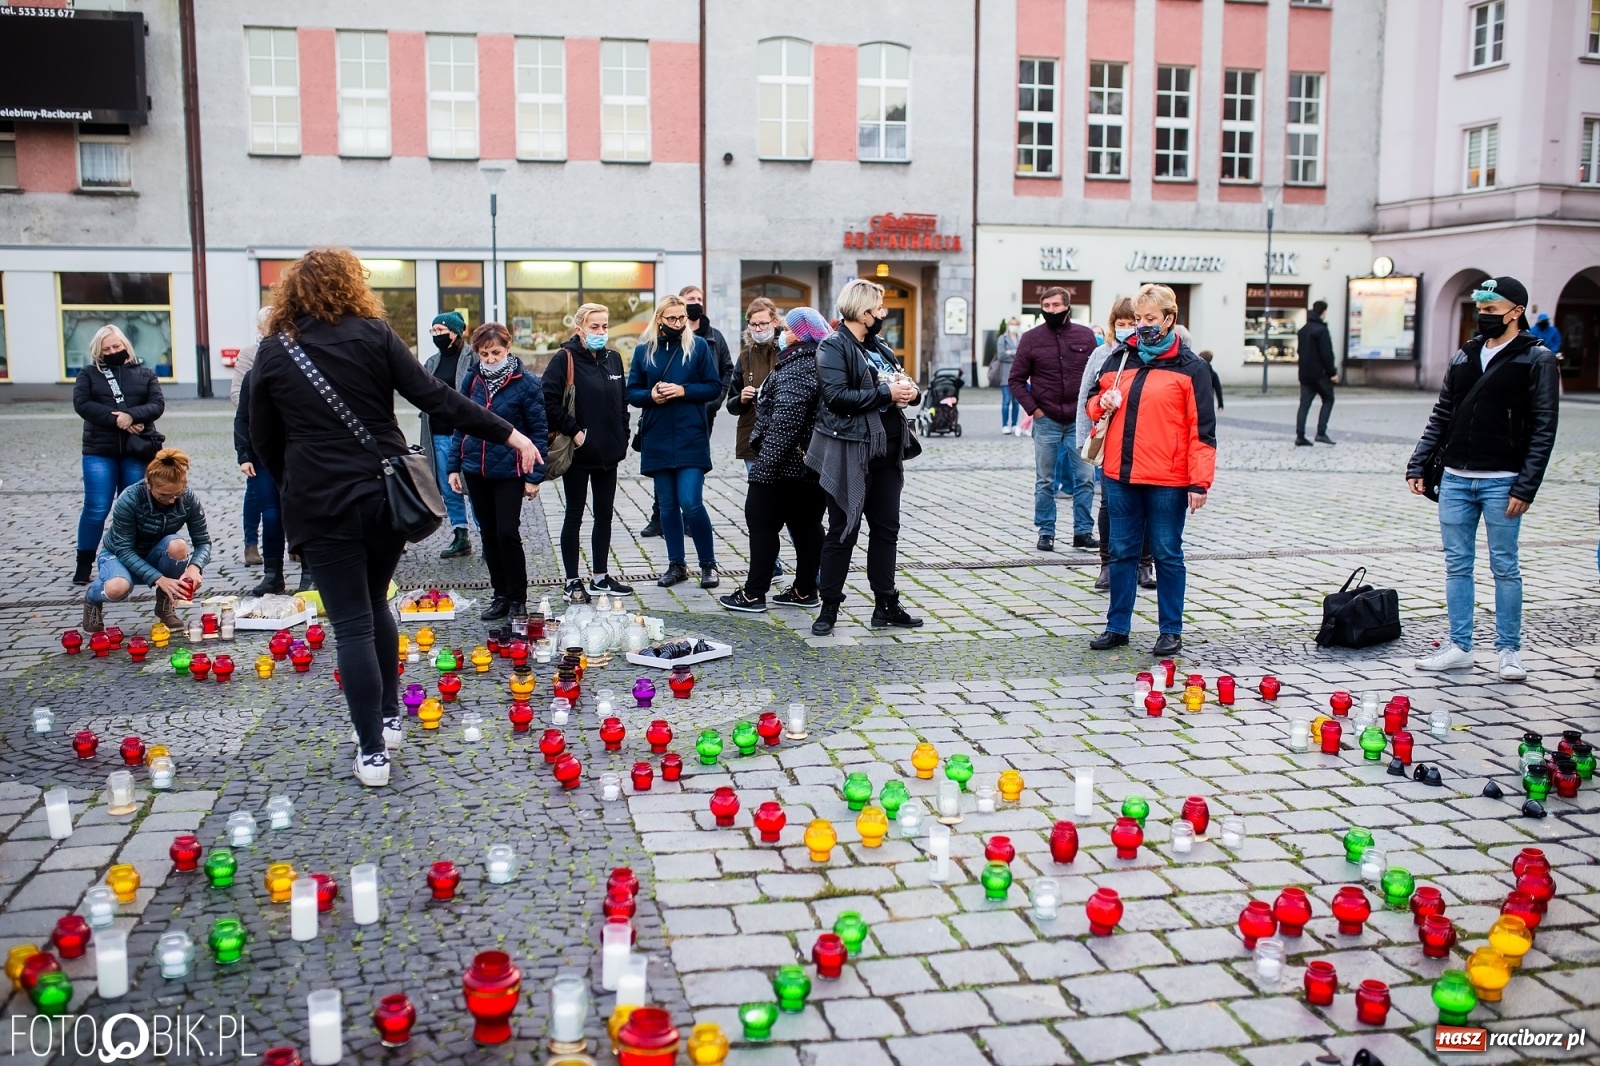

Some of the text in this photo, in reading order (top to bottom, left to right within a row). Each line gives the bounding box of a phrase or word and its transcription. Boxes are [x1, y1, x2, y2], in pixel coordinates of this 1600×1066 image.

[1, 7, 76, 19] tel. 533 355 677
[1125, 249, 1226, 272] JUBILER
